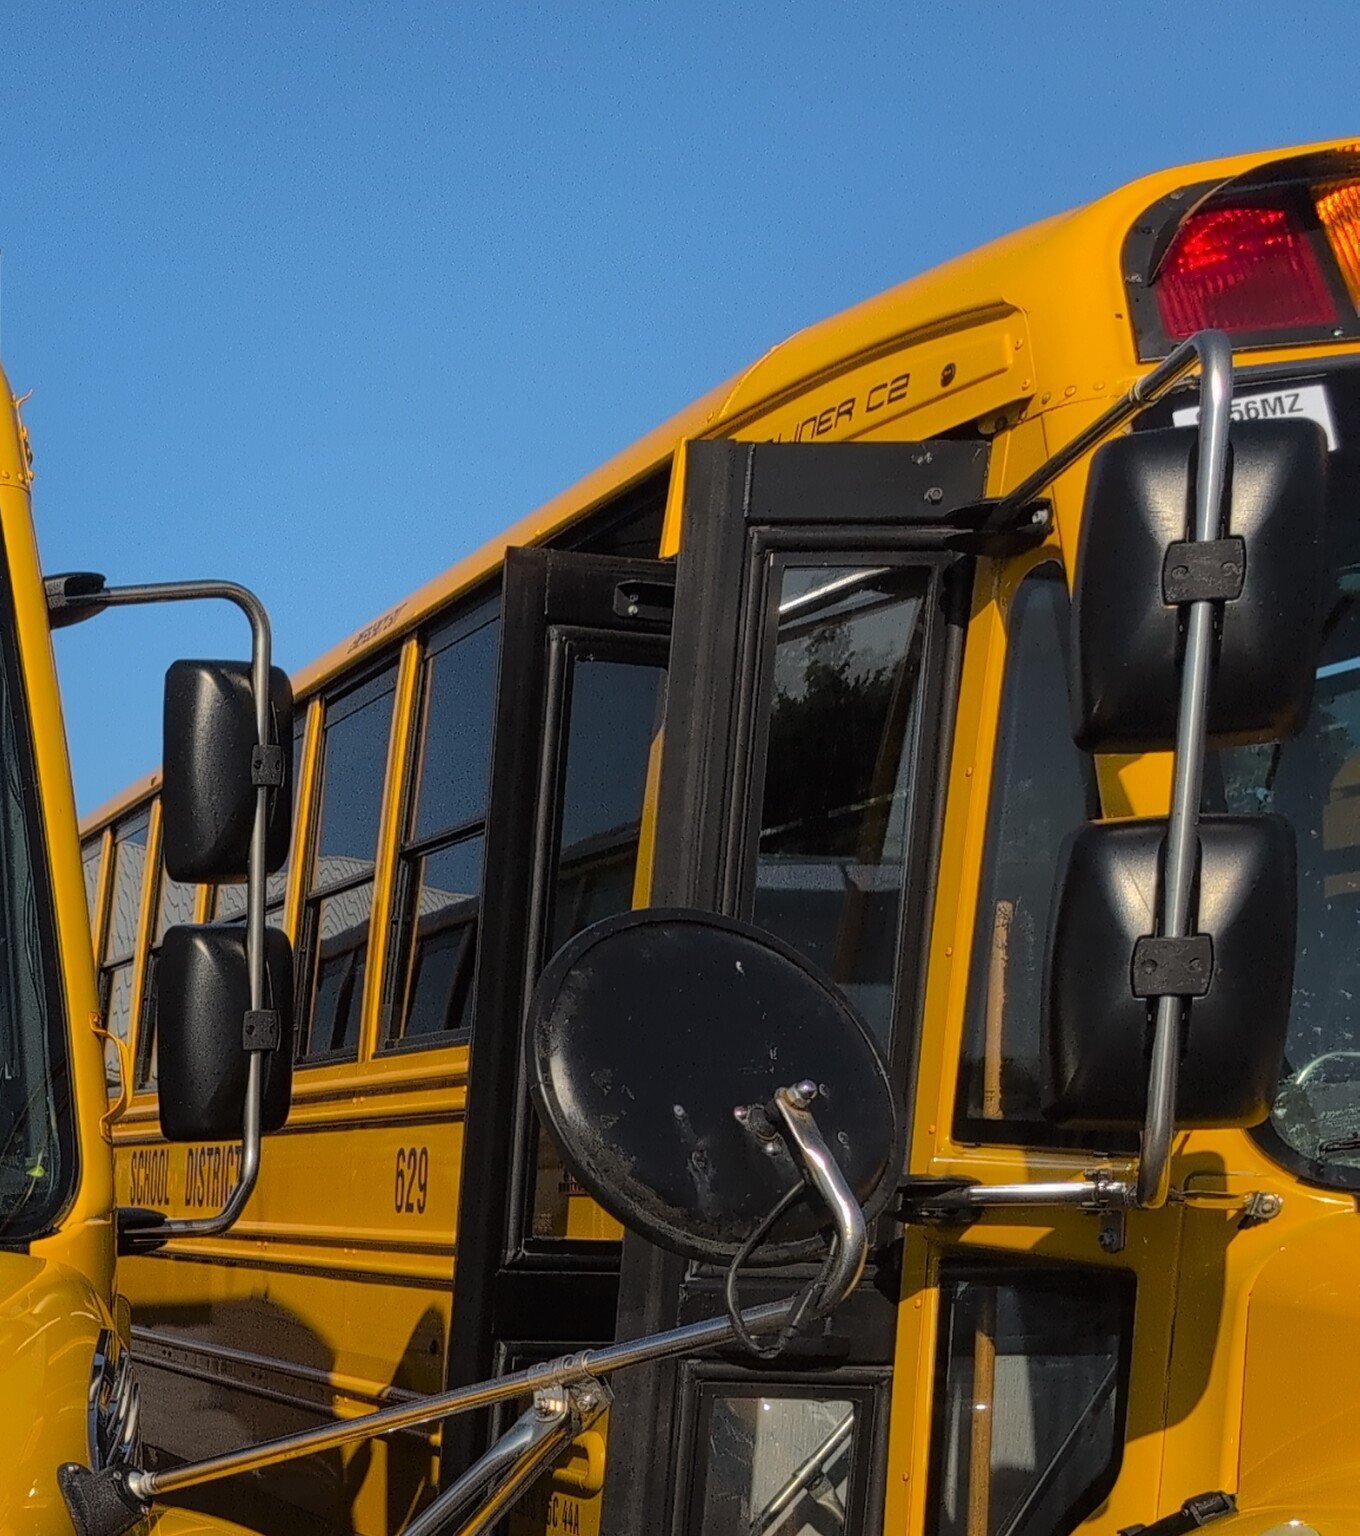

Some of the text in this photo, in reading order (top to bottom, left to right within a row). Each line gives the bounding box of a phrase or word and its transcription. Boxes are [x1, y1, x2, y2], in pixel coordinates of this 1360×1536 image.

[865, 373, 911, 413] C2
[1229, 392, 1304, 421] 56MZ
[130, 1149, 170, 1206] SCHOOL
[395, 1146, 429, 1214] 629
